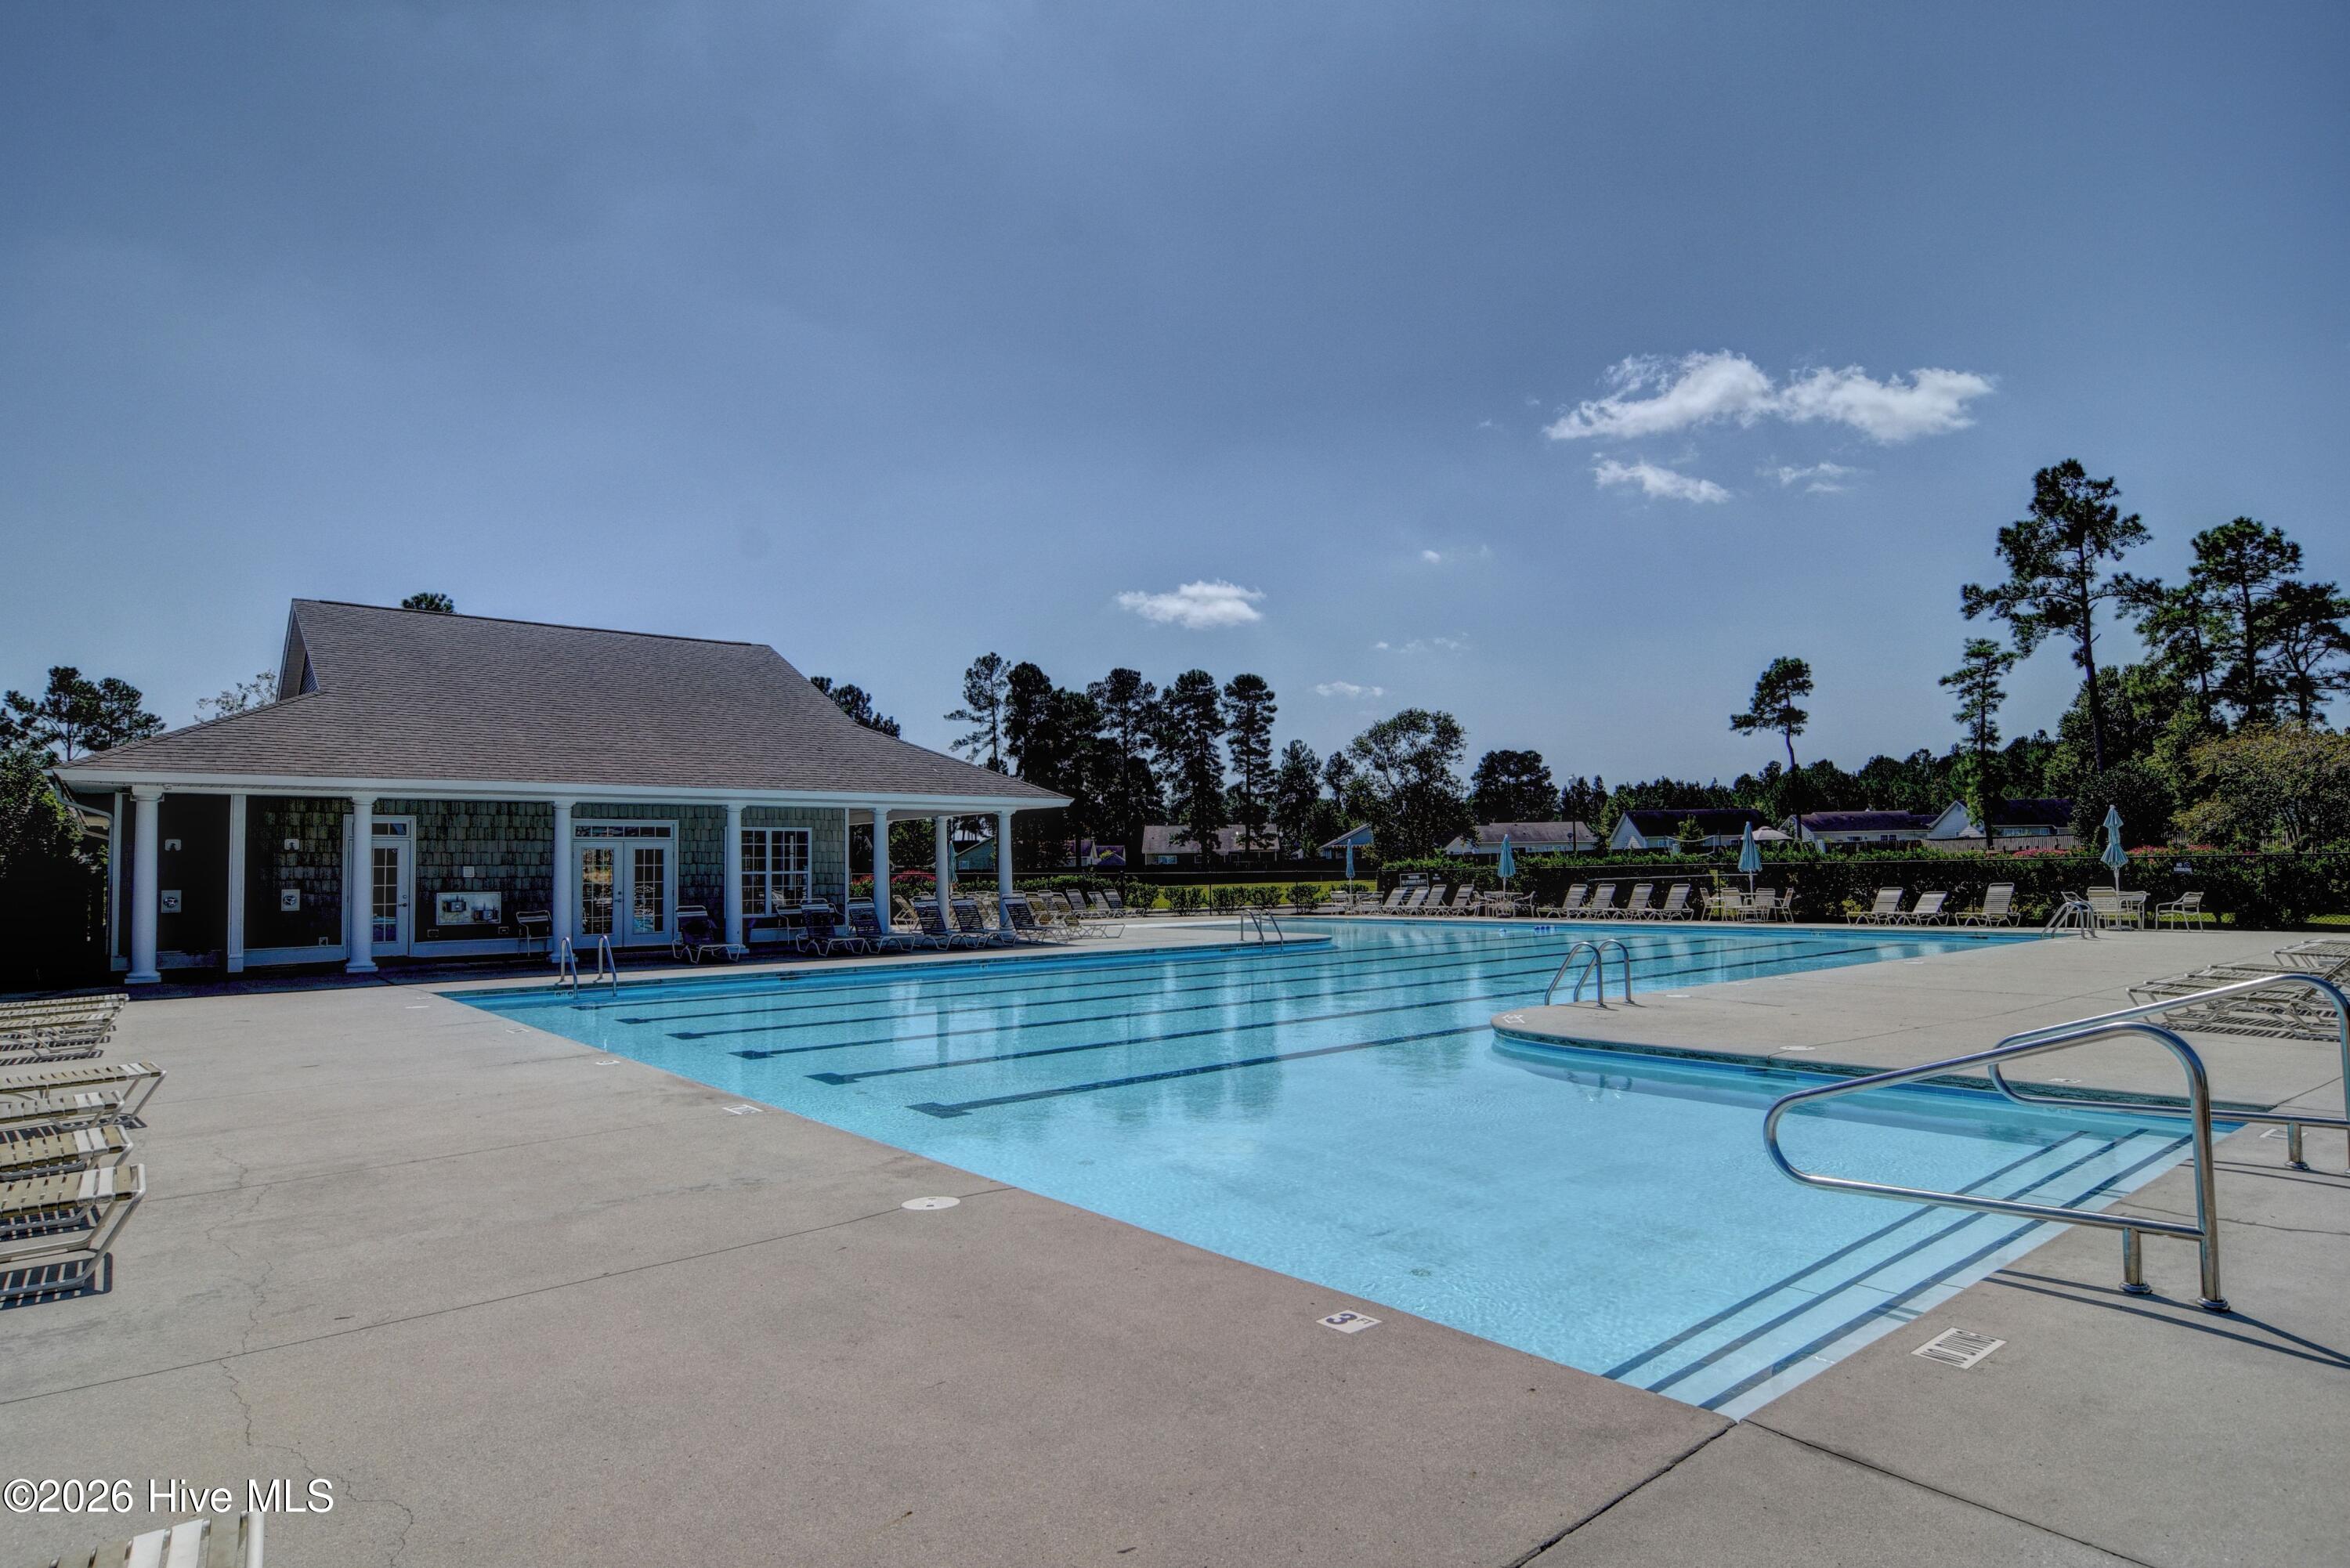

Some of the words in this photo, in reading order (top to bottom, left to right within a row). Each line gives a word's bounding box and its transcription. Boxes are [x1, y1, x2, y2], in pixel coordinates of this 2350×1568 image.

[1325, 1313, 1358, 1325] 3
[1934, 1330, 1997, 1356] DIVING
[1920, 1348, 1969, 1366] NO
